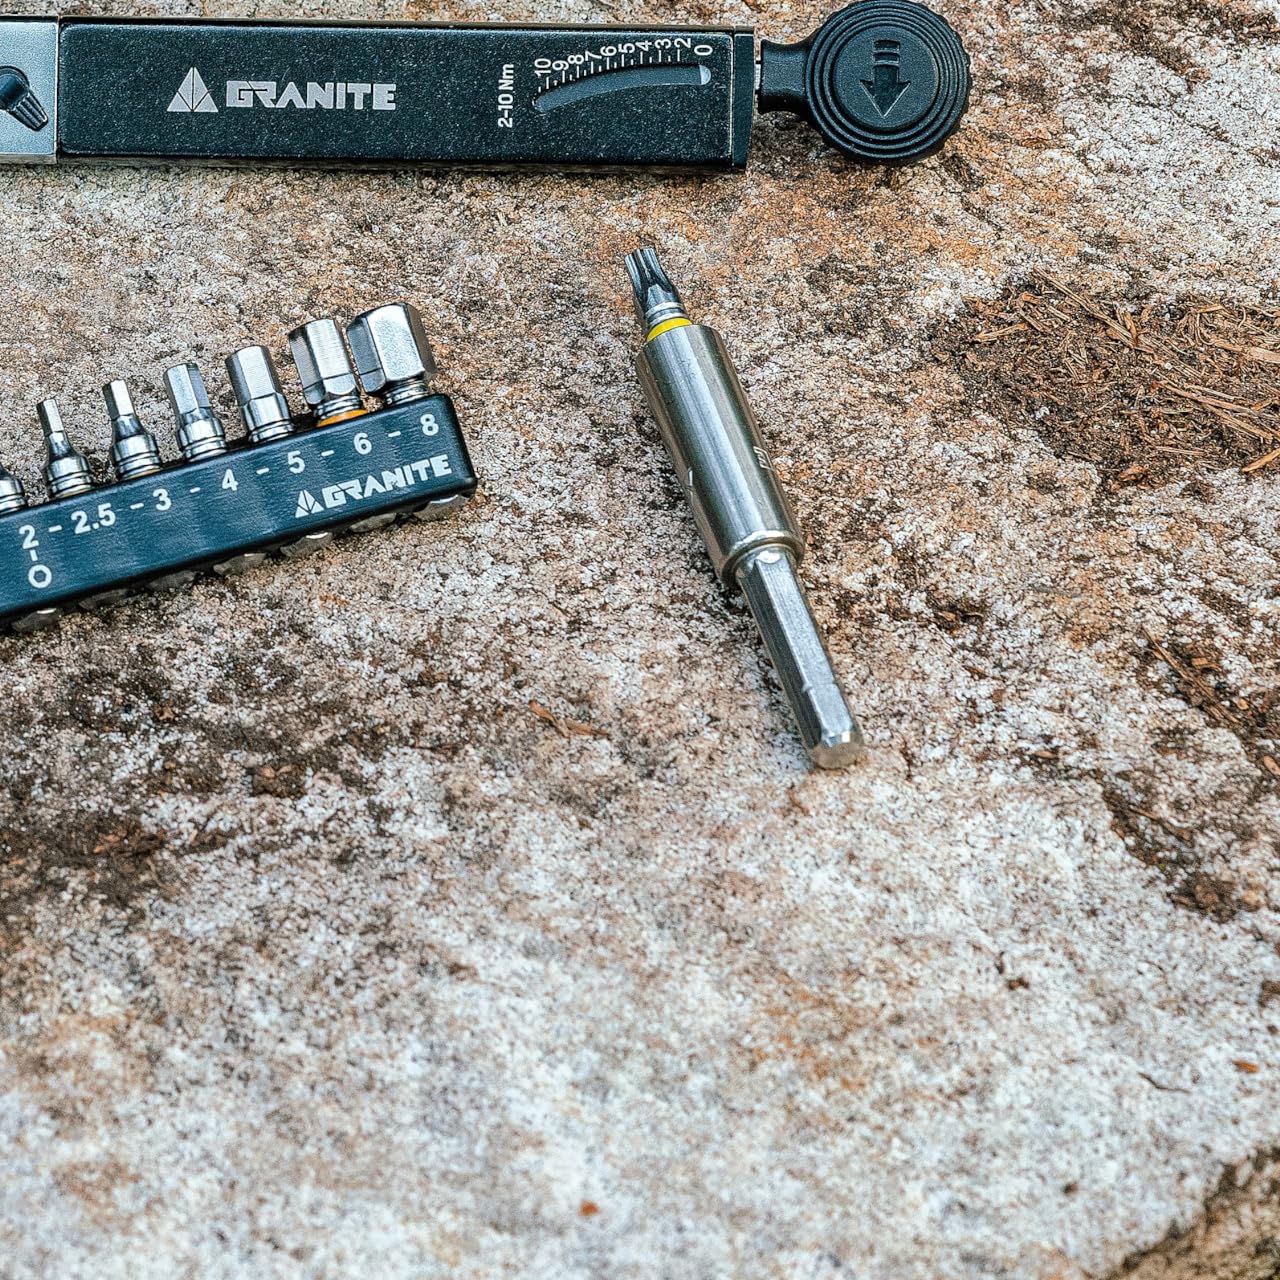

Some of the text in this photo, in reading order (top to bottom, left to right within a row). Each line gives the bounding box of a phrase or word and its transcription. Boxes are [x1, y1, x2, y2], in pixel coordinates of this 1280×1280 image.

[618, 43, 635, 53] 5
[635, 40, 652, 51] 4
[655, 39, 671, 49] 3
[674, 38, 691, 48] 2
[585, 50, 604, 61] 7
[600, 46, 617, 56] 6
[694, 45, 713, 55] 0
[552, 59, 569, 70] 9
[567, 54, 584, 65] 8
[534, 58, 551, 77] 10
[226, 81, 396, 110] GRANITE
[498, 64, 514, 128] 2-10 Nm
[19, 414, 439, 549] 2 2.5 3 4 5 6 8
[322, 454, 453, 508] GRANITE
